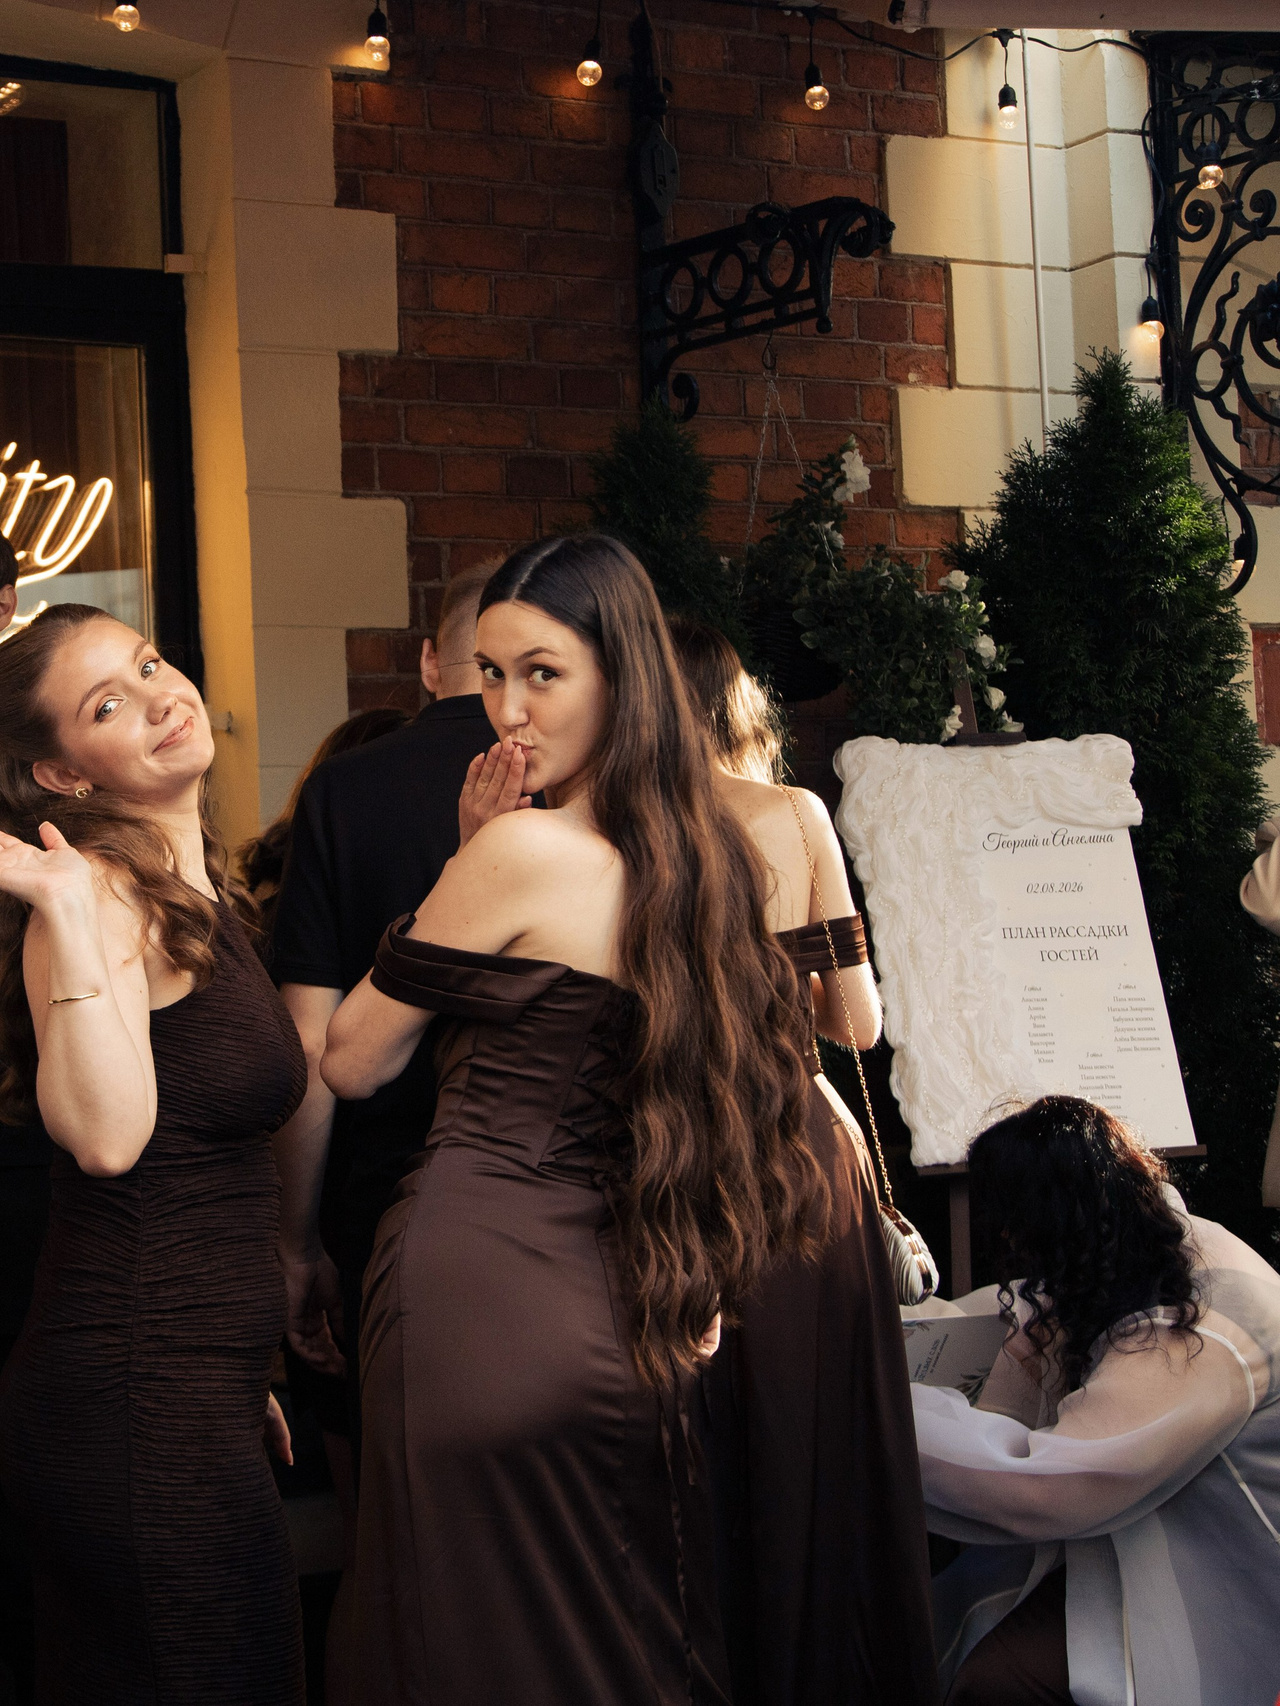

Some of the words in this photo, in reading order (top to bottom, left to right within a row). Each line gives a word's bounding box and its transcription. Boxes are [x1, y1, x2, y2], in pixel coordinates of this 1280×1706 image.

[982, 832, 1039, 854] Георгий
[1041, 836, 1050, 847] и
[1050, 827, 1115, 847] Ангелина
[1025, 881, 1084, 894] 02.08.2026
[1001, 926, 1047, 940] ПЛАН
[1048, 924, 1129, 940] РАССАДКИ
[1039, 945, 1099, 962] ГОСТЕЙ
